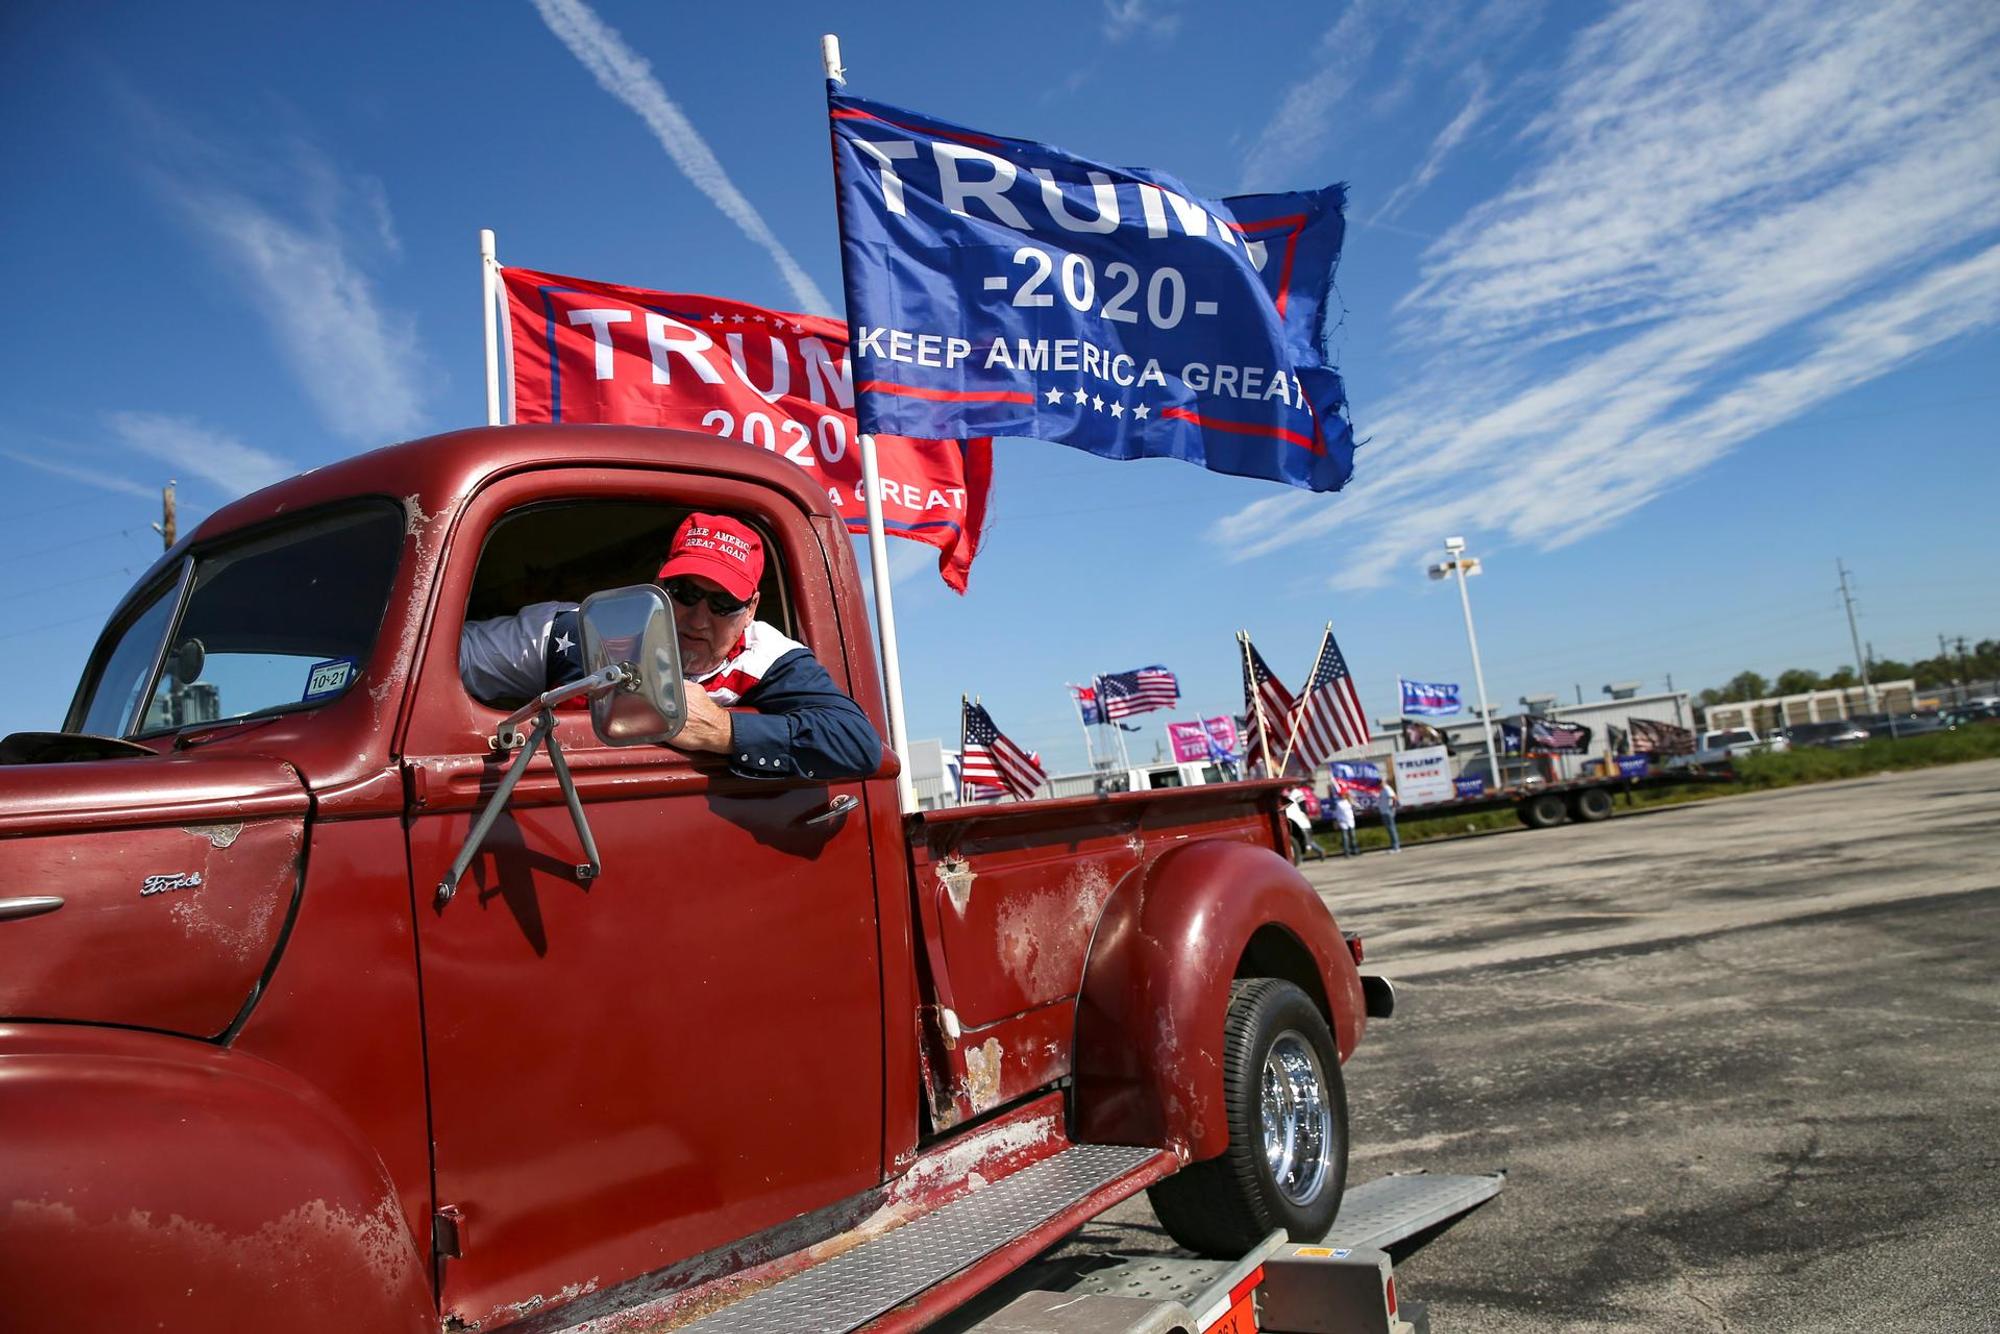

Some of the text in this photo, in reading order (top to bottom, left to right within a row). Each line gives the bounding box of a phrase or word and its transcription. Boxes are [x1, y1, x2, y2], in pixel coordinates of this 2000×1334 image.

[983, 247, 1218, 329] -2020-
[567, 308, 855, 409] TRUM
[858, 326, 1313, 416] KEEP AMERICA GREAT
[1396, 756, 1443, 769] TRUMP
[140, 871, 202, 895] Ford
